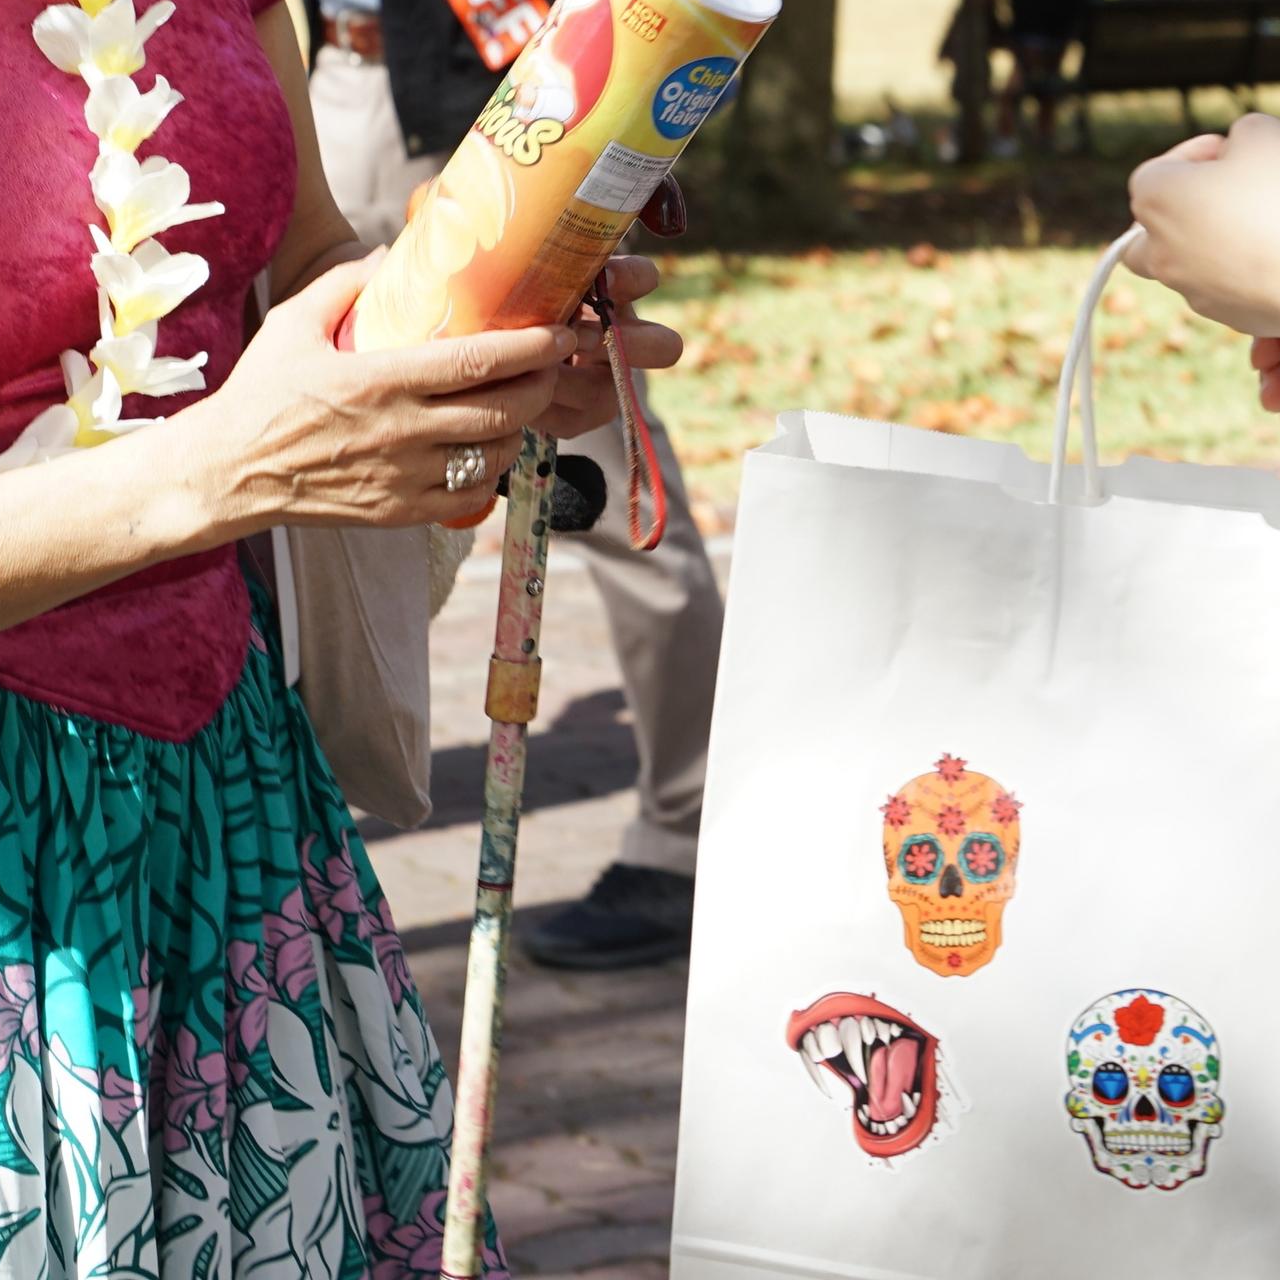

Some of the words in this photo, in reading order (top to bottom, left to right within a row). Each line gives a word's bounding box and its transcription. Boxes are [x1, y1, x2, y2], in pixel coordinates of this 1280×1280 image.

[621, 7, 658, 42] FRIED
[631, 0, 664, 27] NON
[688, 65, 730, 88] Chip
[661, 81, 721, 111] Origin
